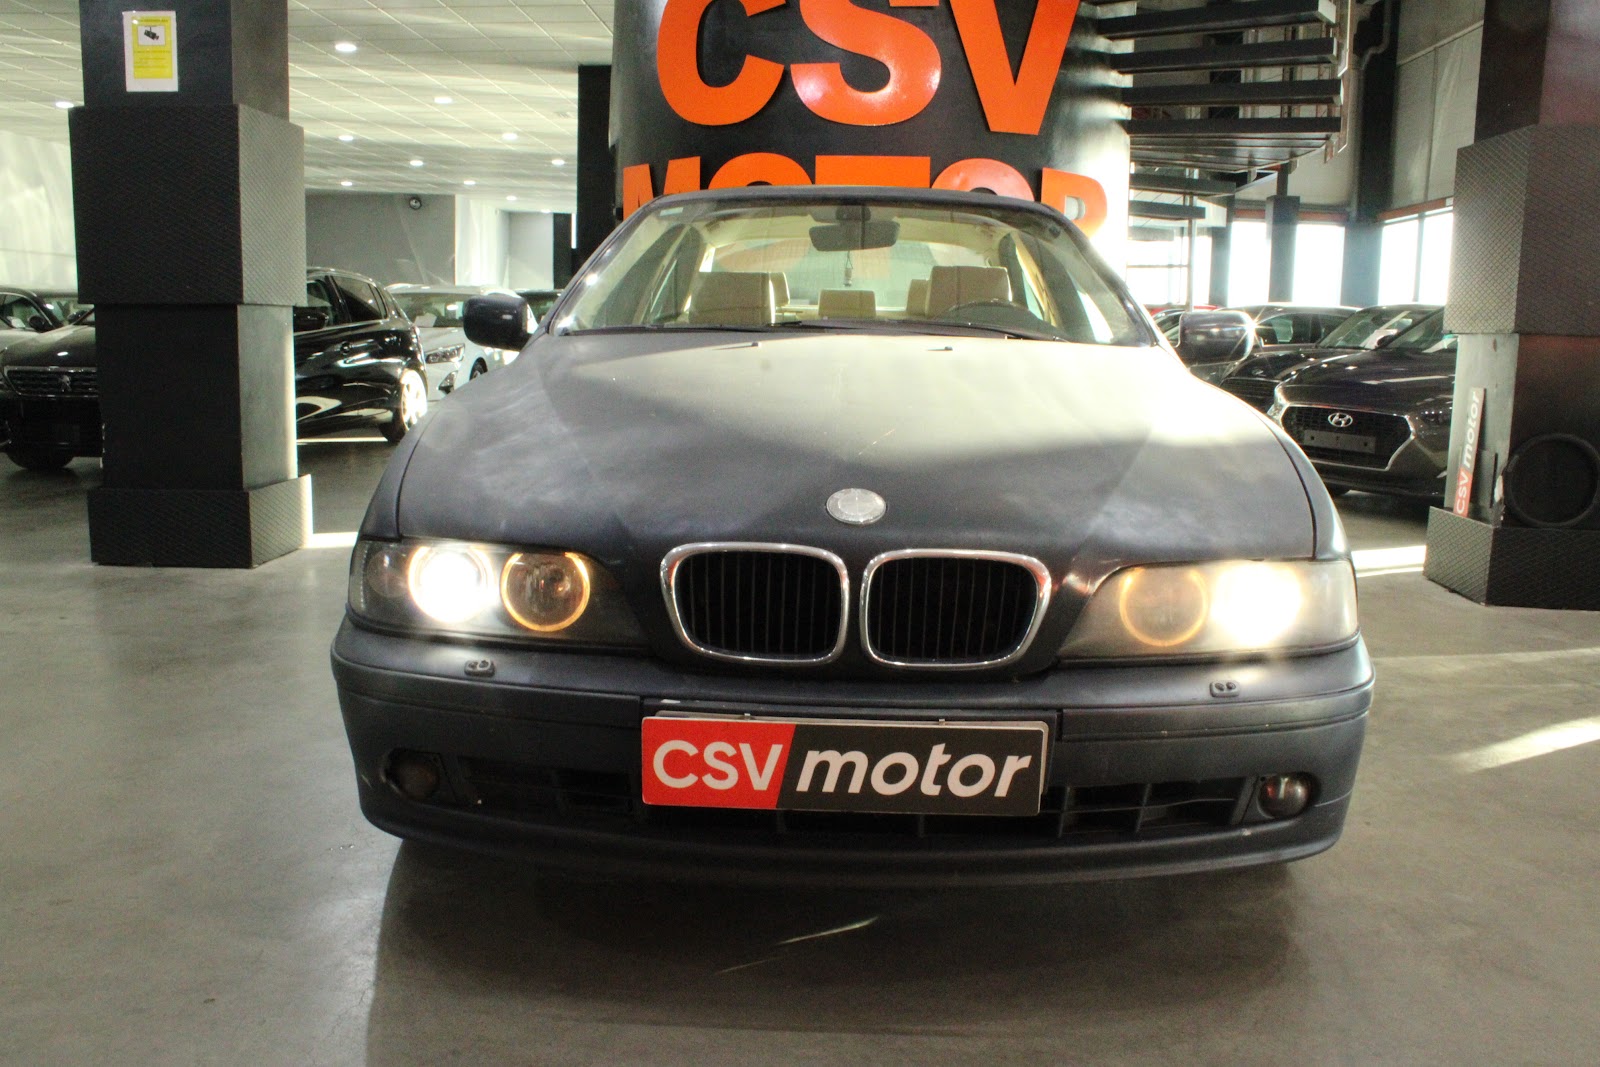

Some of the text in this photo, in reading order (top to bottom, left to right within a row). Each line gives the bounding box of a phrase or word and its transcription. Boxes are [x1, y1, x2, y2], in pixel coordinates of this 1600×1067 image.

[657, 0, 1080, 136] CSV
[1456, 391, 1480, 514] CSV motor
[653, 739, 1032, 798] CSV motor
